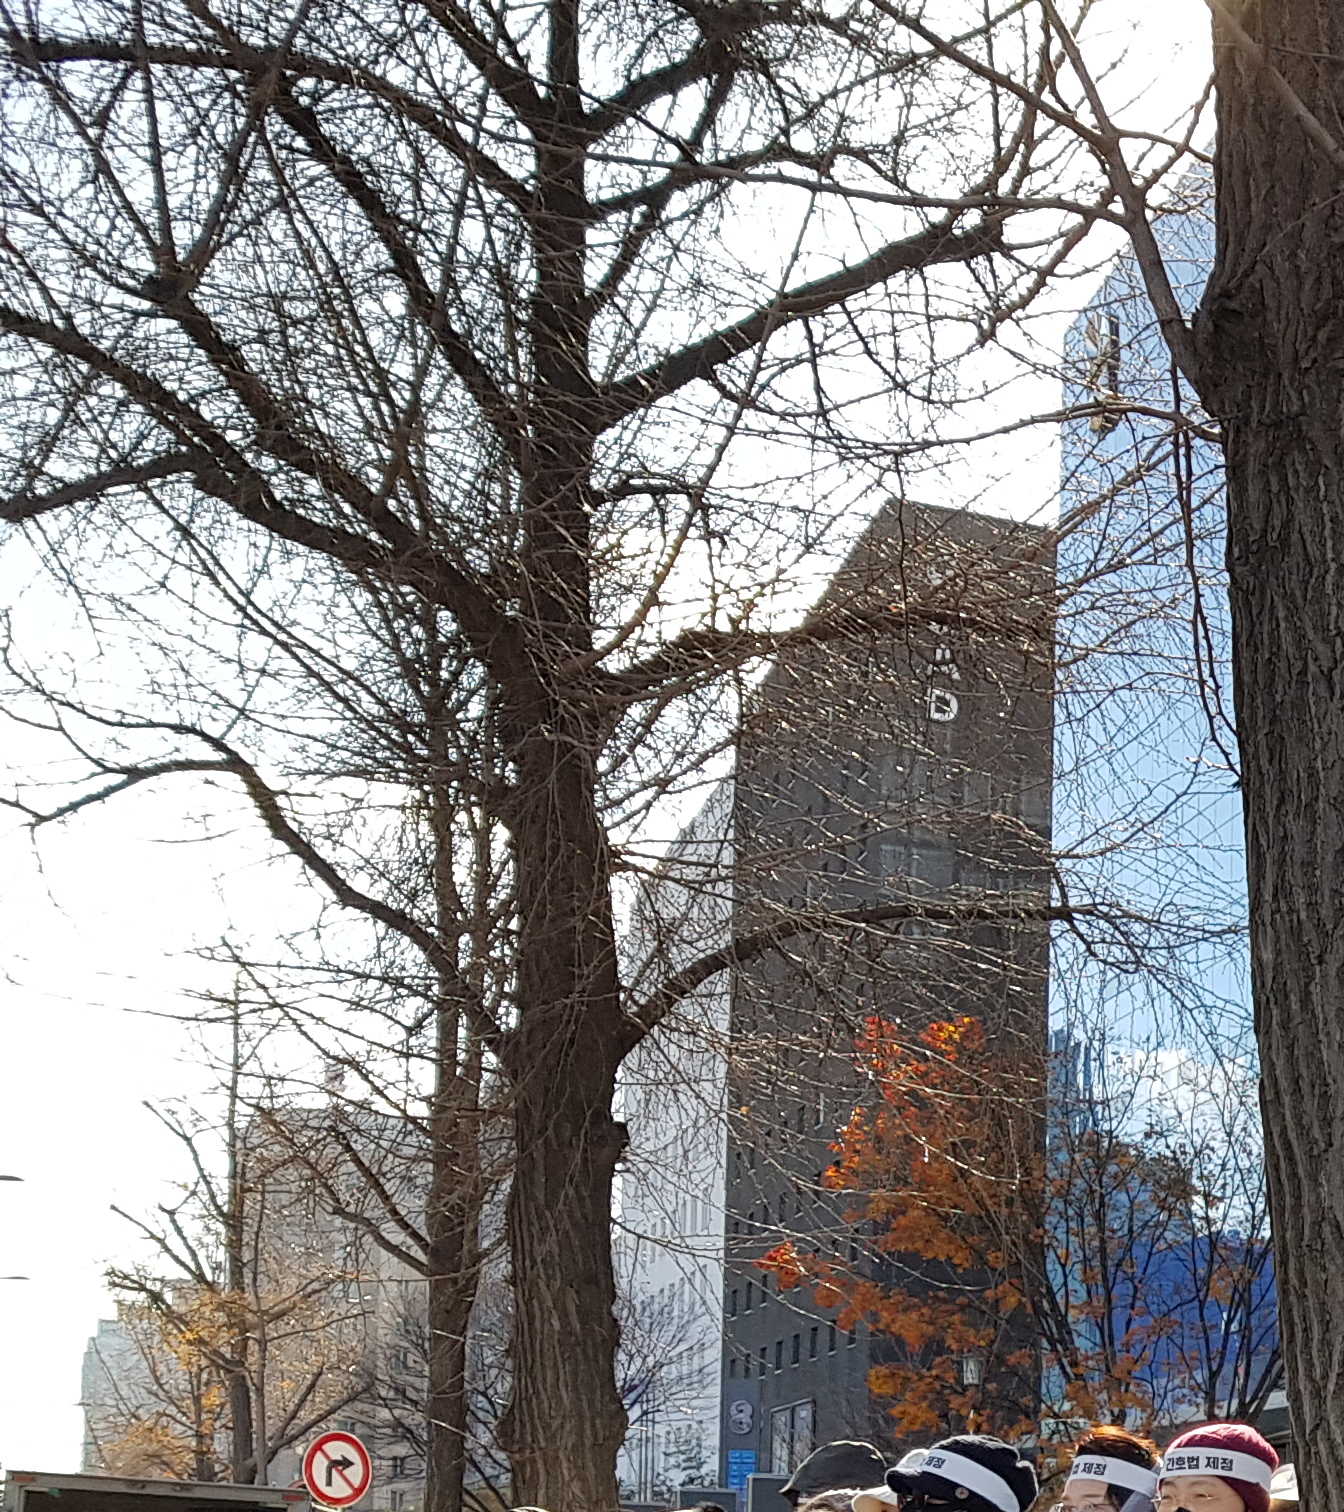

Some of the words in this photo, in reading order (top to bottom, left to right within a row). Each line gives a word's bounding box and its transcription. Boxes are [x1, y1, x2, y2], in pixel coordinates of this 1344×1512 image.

[1081, 1462, 1107, 1476] 제정
[1166, 1454, 1201, 1472] 간호법
[1205, 1454, 1235, 1472] 제정
